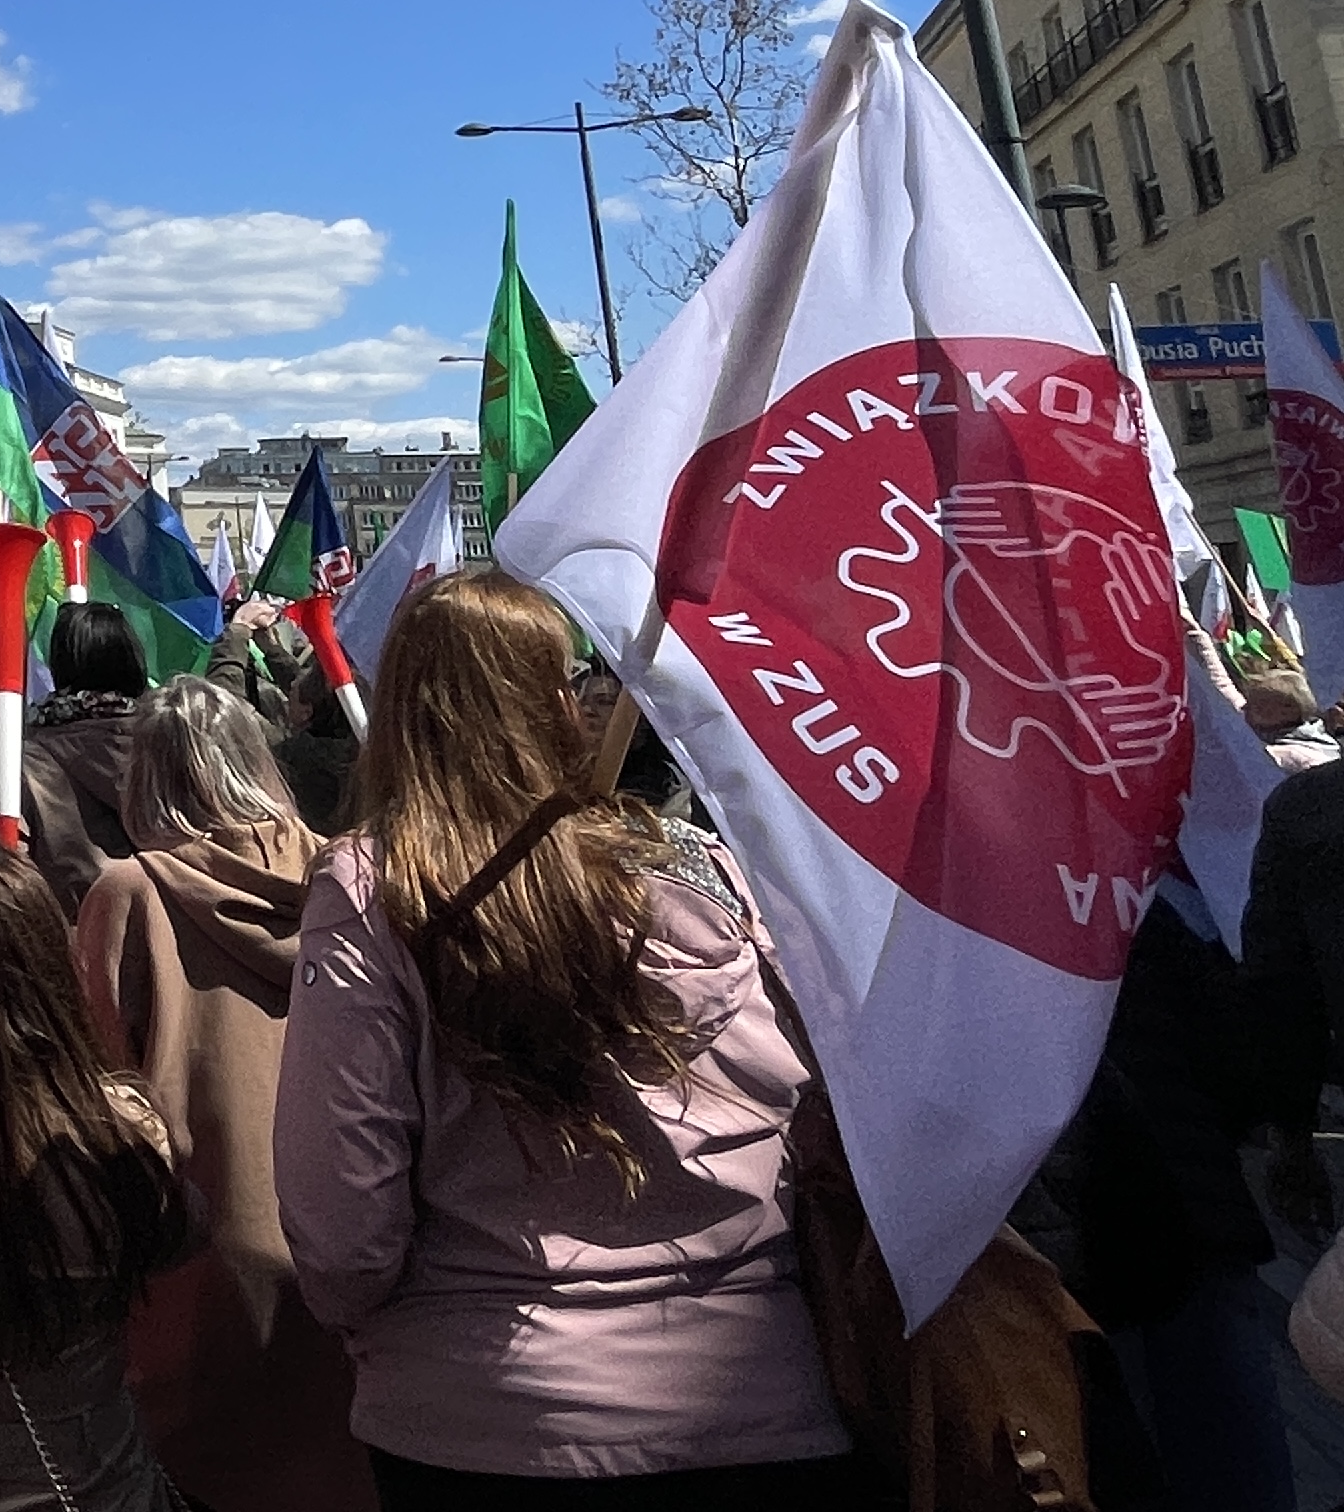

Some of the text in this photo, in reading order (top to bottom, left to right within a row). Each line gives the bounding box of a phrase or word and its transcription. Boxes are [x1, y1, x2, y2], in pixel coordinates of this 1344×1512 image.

[1209, 334, 1264, 360] Puch
[723, 370, 1102, 509] ZWIĄZKO
[752, 659, 900, 804] ZUS
